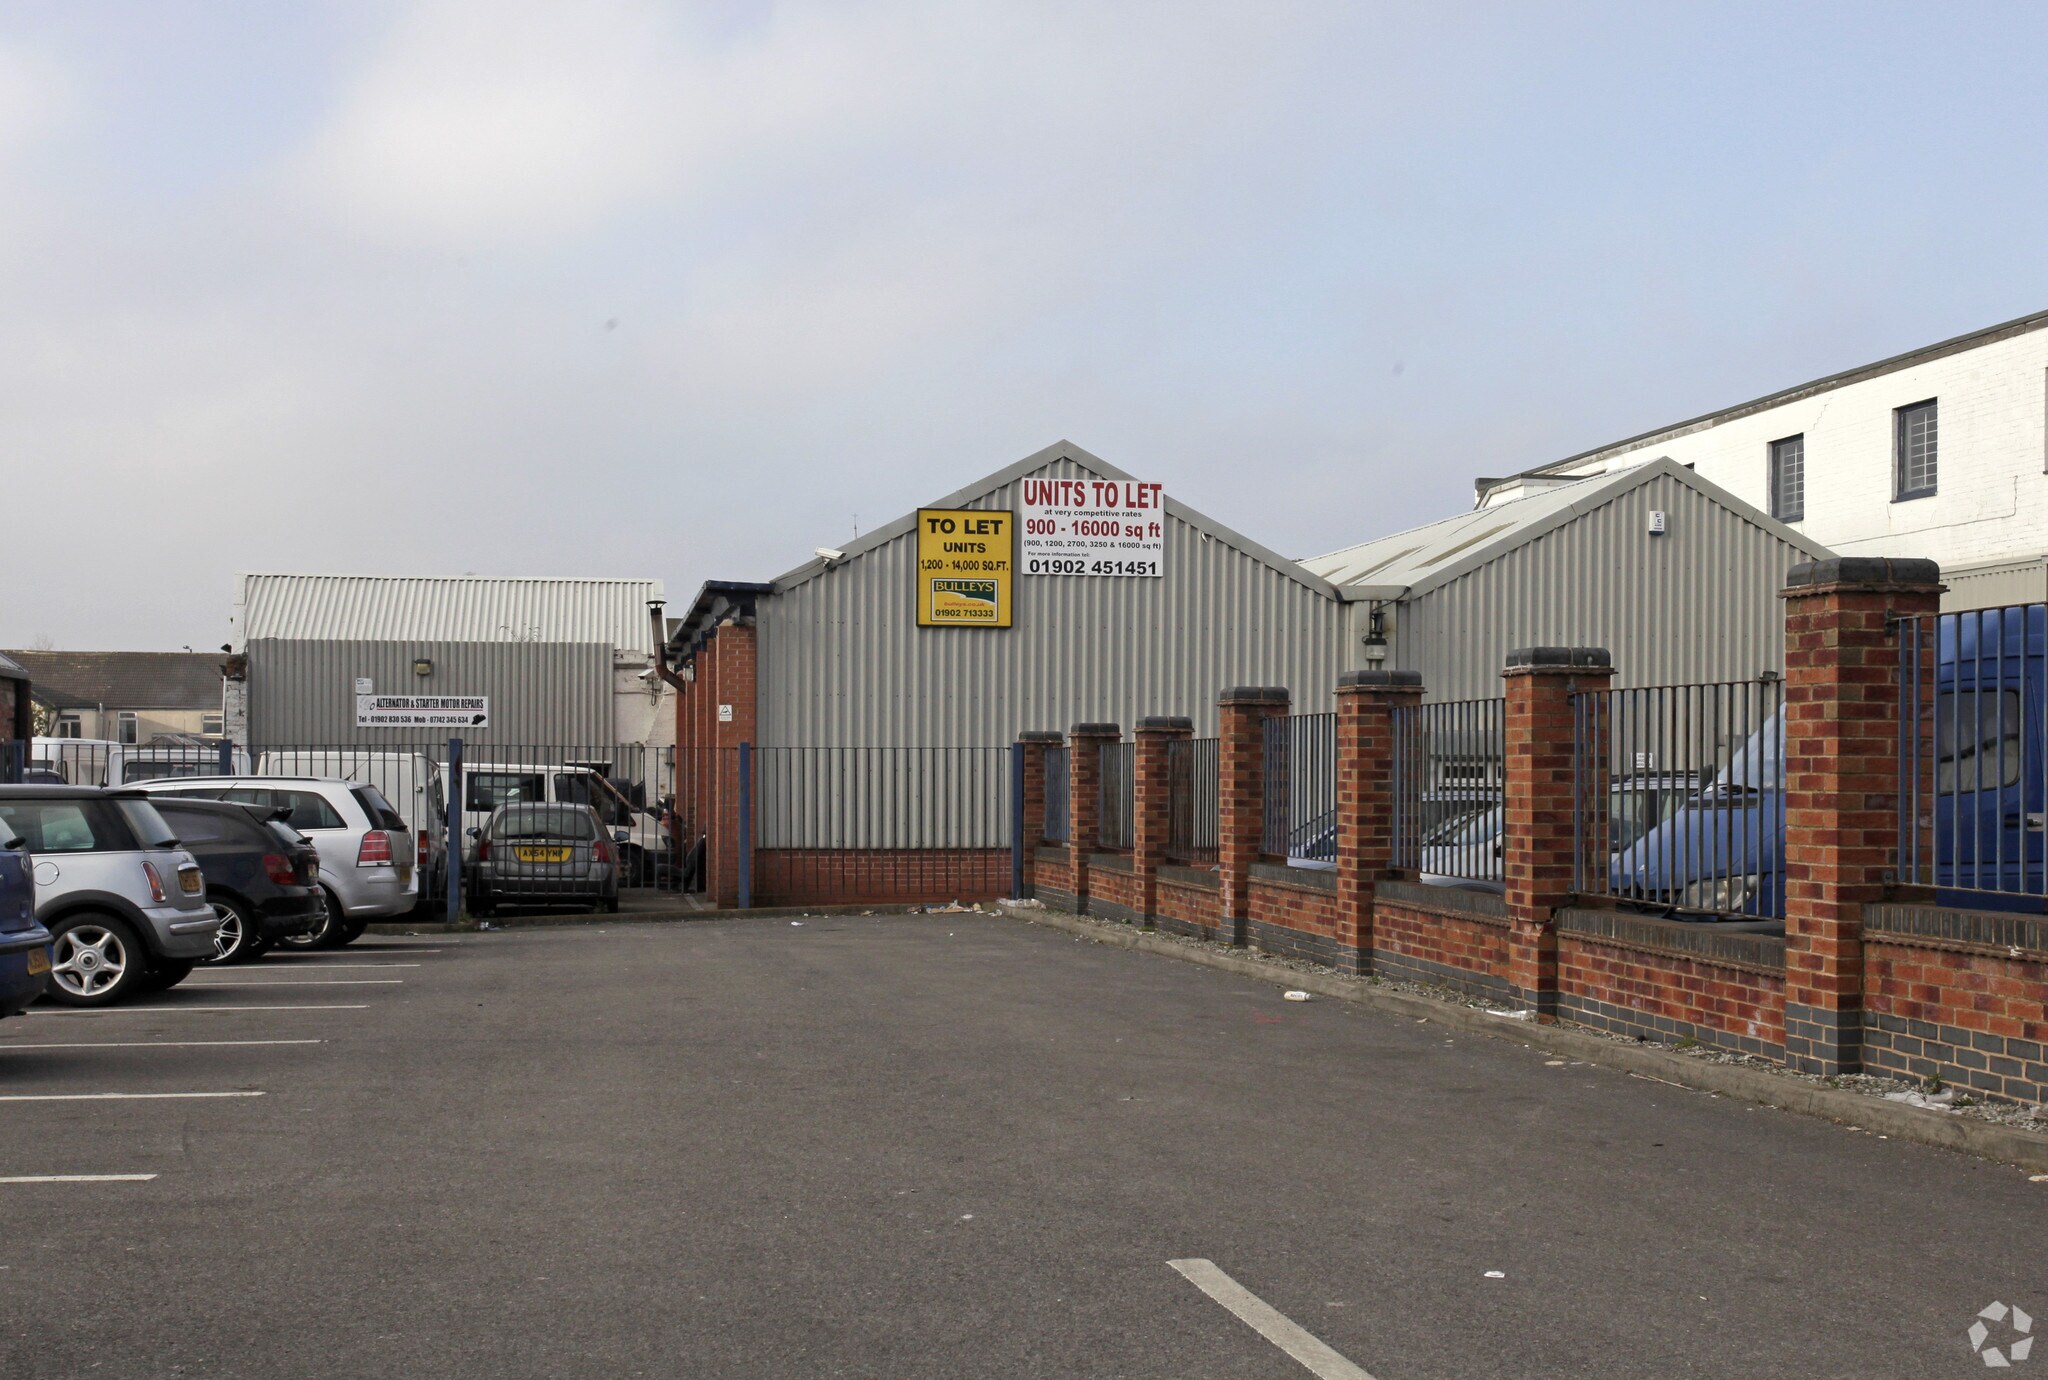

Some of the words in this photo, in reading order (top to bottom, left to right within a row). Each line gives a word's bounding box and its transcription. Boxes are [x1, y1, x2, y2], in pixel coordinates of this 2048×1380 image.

[1024, 480, 1086, 507] UNITS
[1092, 482, 1118, 508] TO
[1126, 483, 1162, 508] LET
[927, 518, 956, 534] TO
[964, 519, 1003, 535] LET
[1026, 518, 1056, 535] 900
[1072, 520, 1120, 536] 16000
[1125, 524, 1143, 540] sq
[1148, 522, 1160, 538] ft
[944, 542, 986, 553] UNITS
[921, 559, 943, 571] 1,200
[952, 560, 979, 572] 14,000
[982, 561, 1008, 571] SQ.FT.
[1030, 560, 1085, 574] 01902
[1091, 561, 1156, 574] 451451
[935, 582, 994, 592] BULLEYS
[376, 698, 409, 708] ALTERNATOR
[416, 699, 439, 708] STARTER
[440, 699, 460, 708] MOTOR
[461, 699, 483, 708] REPAIRS
